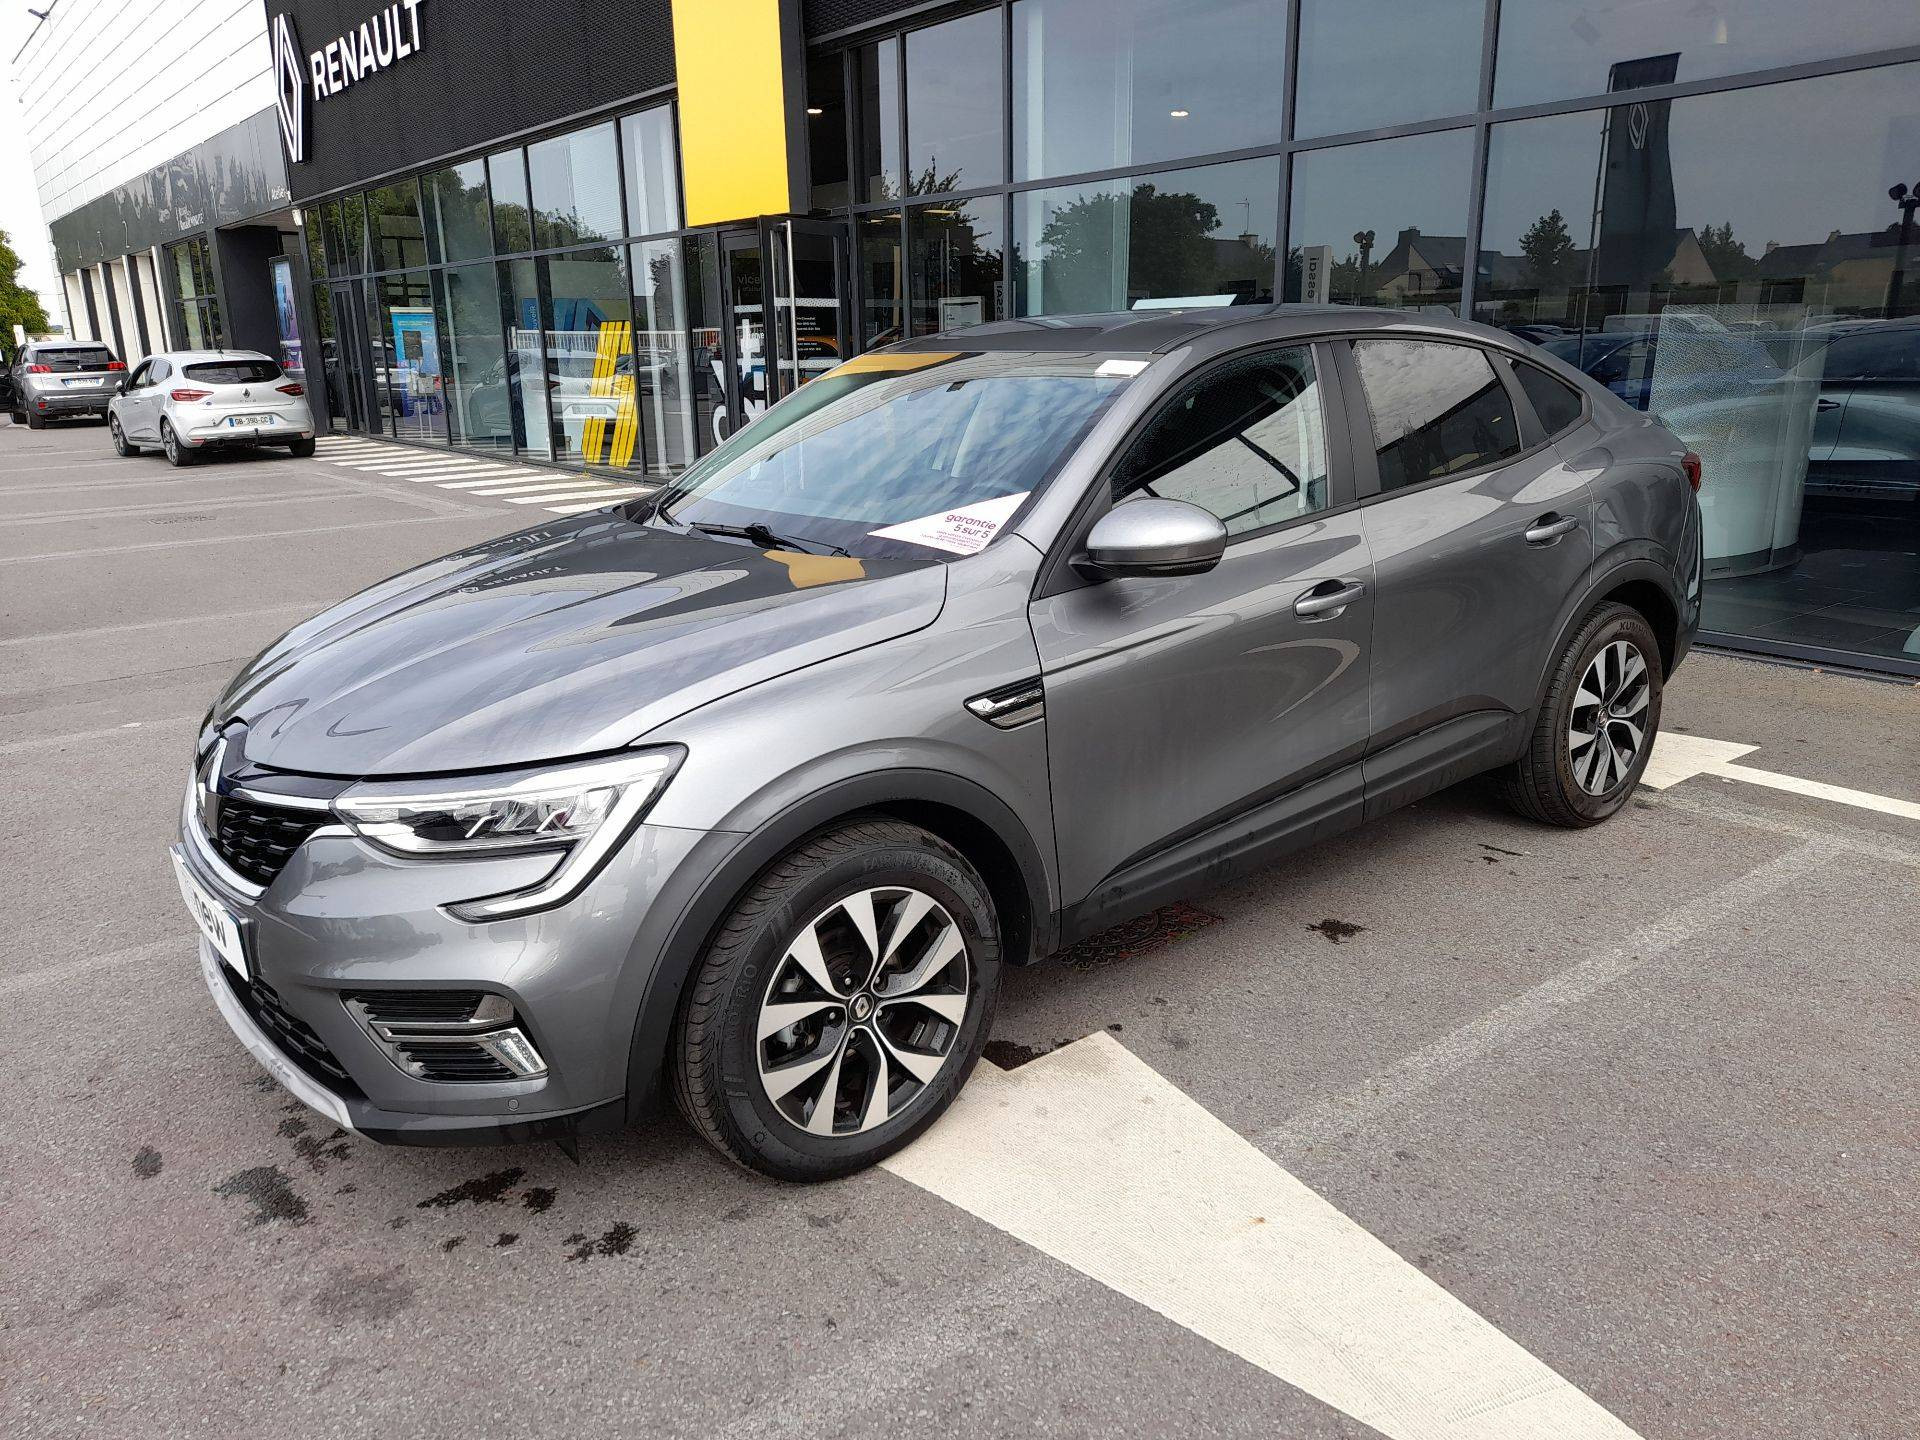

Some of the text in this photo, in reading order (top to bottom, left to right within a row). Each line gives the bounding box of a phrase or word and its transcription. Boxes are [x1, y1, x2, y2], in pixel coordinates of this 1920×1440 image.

[310, 0, 422, 101] RENAULT
[945, 513, 997, 530] garantie
[953, 524, 991, 539] 5 sur 5
